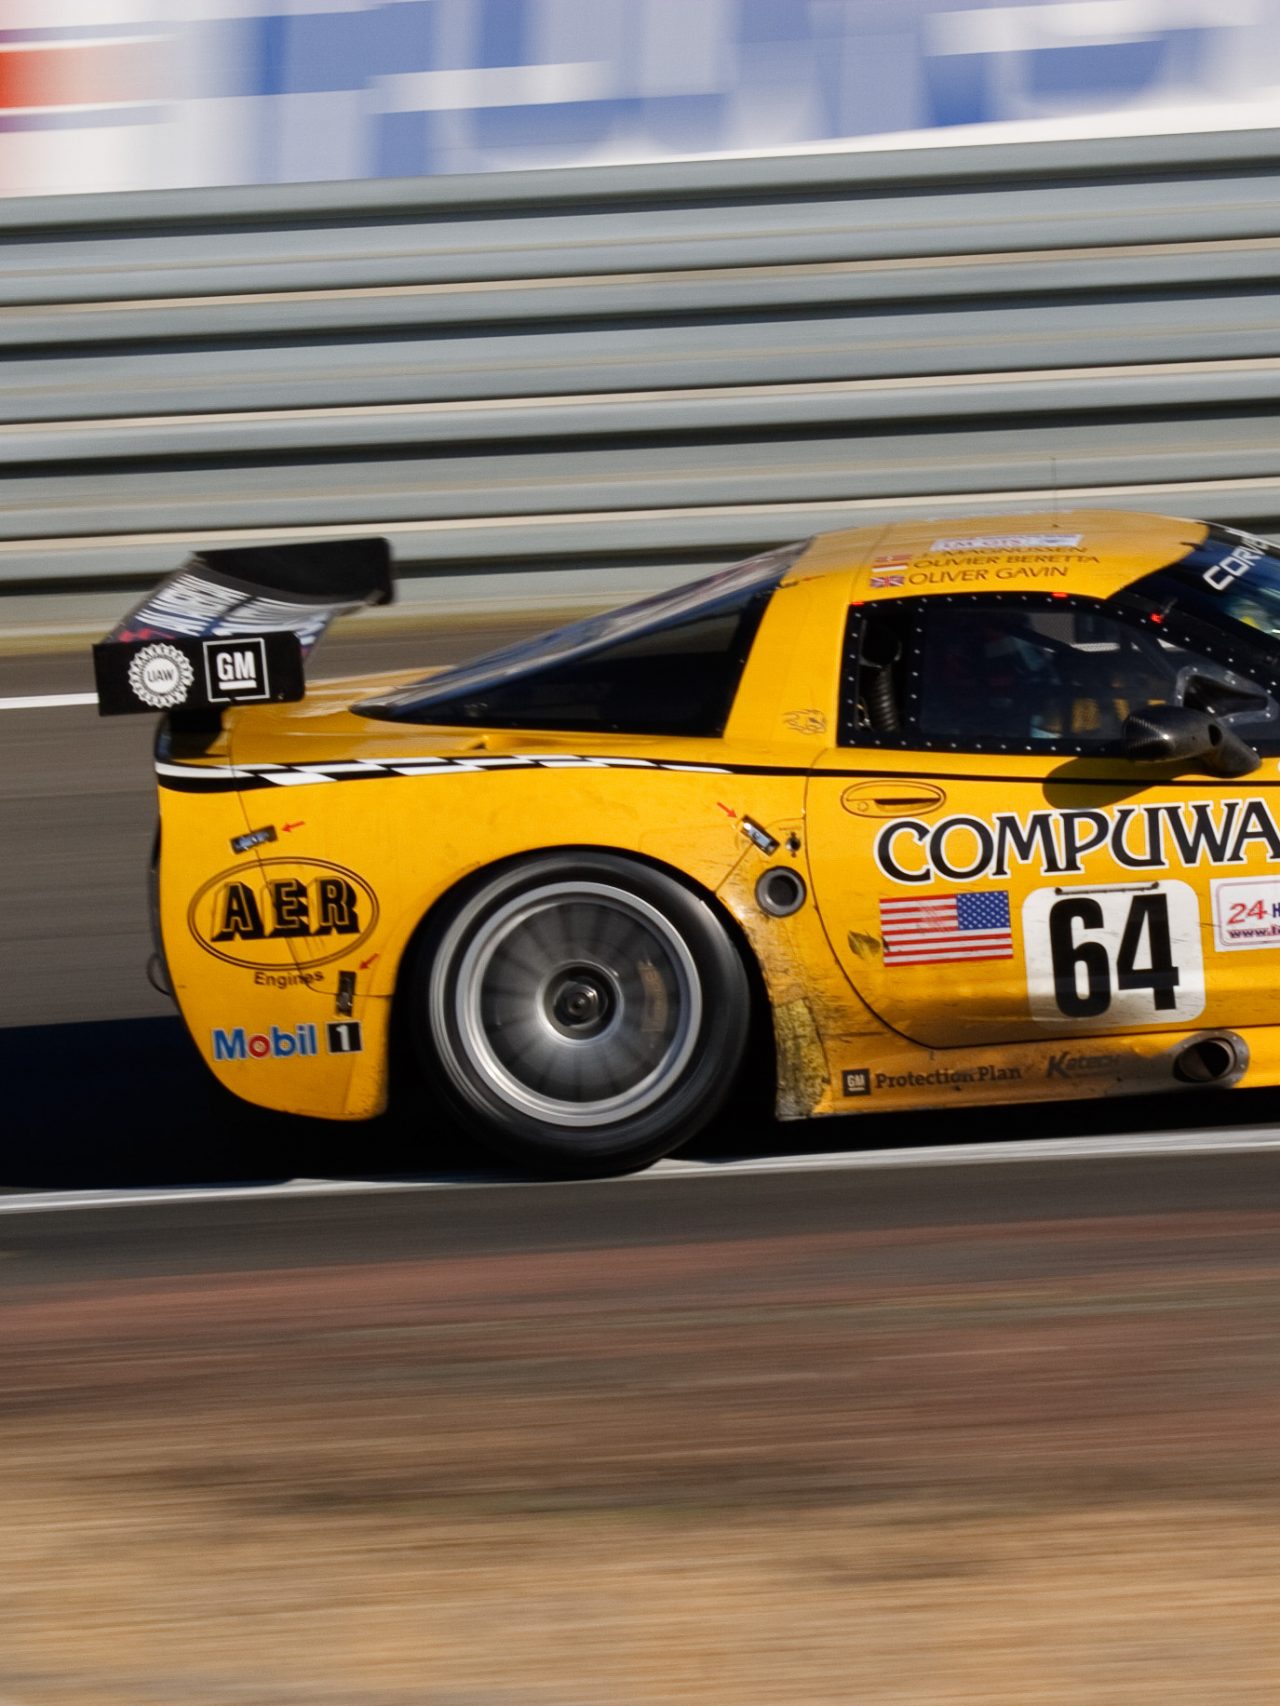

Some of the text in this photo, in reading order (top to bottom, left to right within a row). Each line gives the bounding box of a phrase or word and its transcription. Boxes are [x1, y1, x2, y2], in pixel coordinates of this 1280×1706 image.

[908, 566, 1068, 585] OLIVER GAVIN
[146, 669, 175, 683] UAW
[216, 651, 256, 681] GM
[211, 876, 360, 942] AER
[1228, 900, 1267, 925] 24
[1048, 893, 1180, 1019] 64
[254, 970, 325, 989] Engines
[212, 1024, 317, 1061] Mobil
[846, 1065, 1022, 1089] GM Protection Plan
